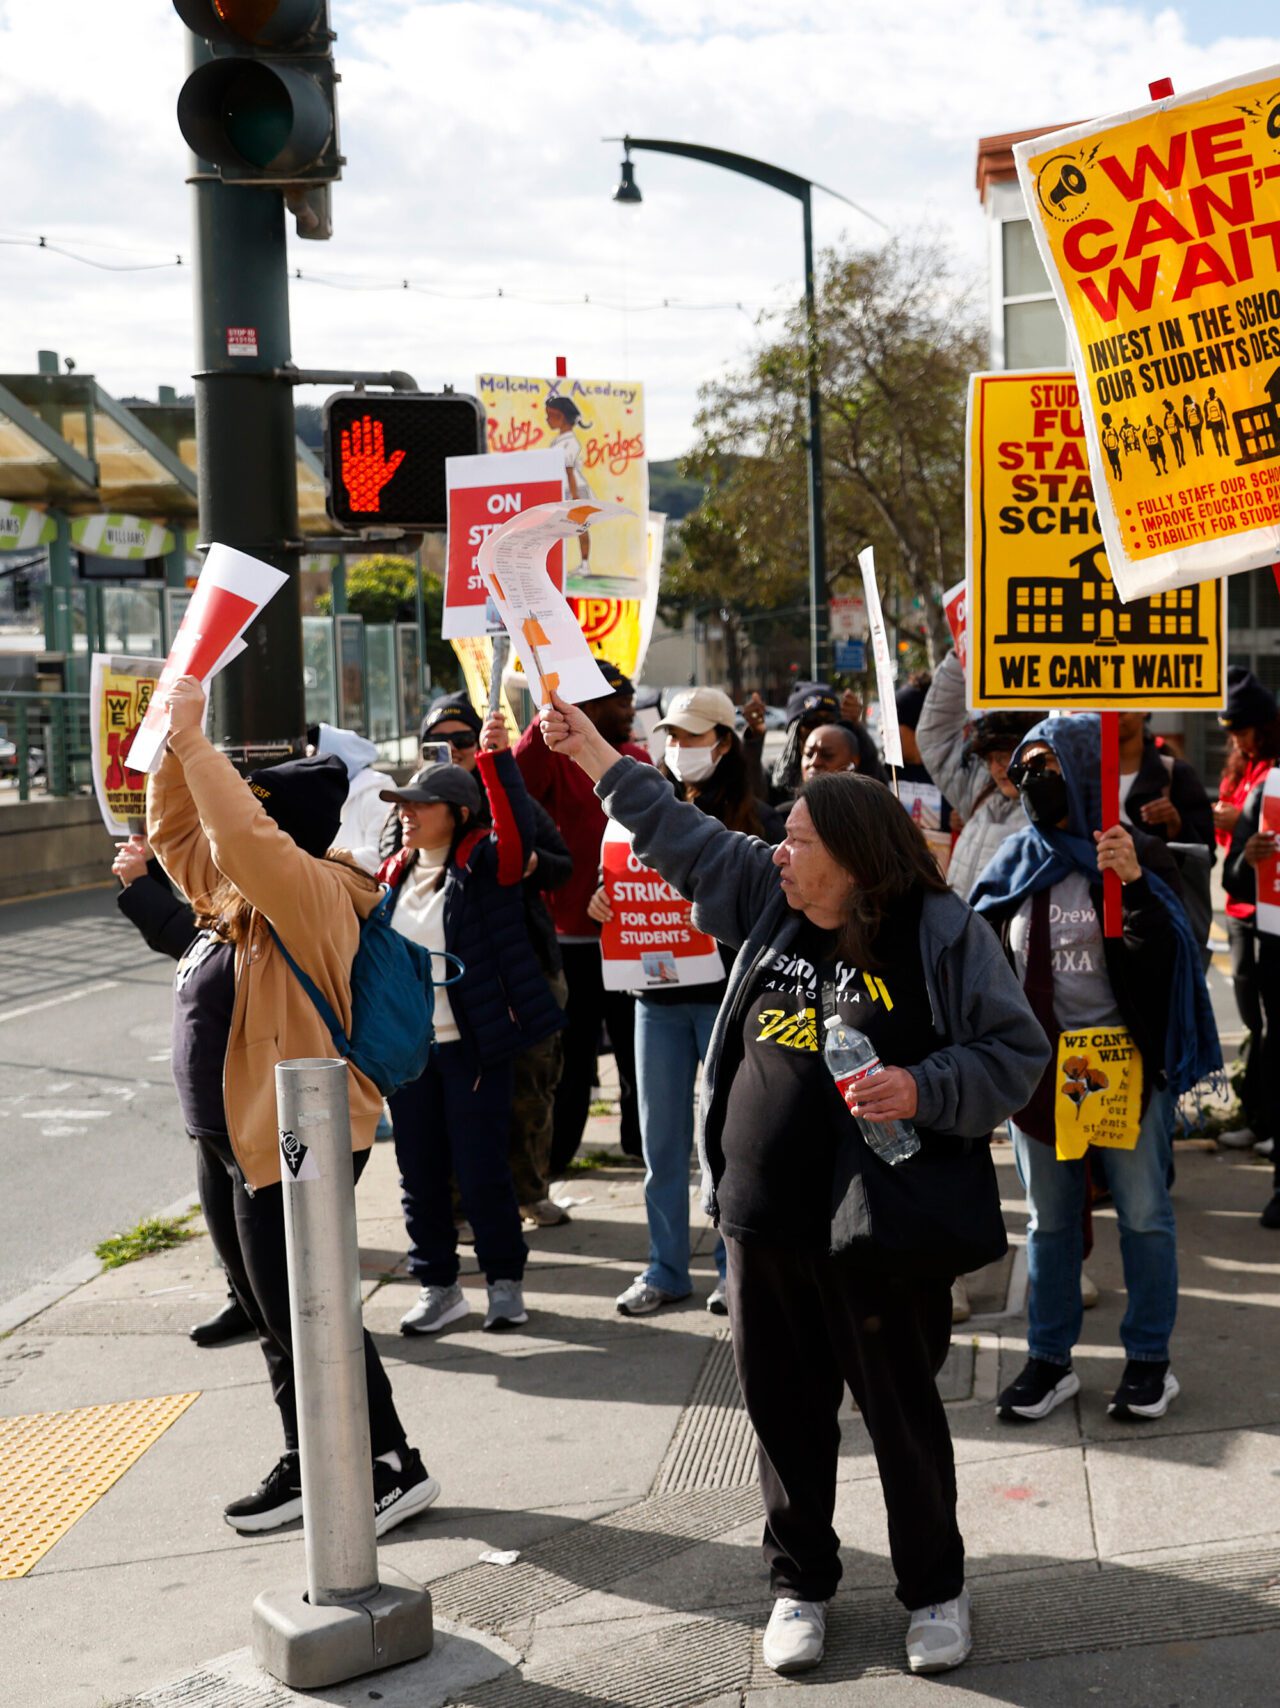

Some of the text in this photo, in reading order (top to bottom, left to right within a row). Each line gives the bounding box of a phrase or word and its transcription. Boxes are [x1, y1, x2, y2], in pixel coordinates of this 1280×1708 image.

[1097, 118, 1254, 202] WE
[1088, 325, 1154, 374] INVEST
[1158, 317, 1185, 352] IN
[1188, 304, 1235, 342] THE
[1096, 368, 1137, 406] OUR
[1139, 336, 1250, 394] STUDENTS
[480, 375, 637, 404] Malcolm X Academy
[584, 430, 645, 476] Bridges
[486, 492, 522, 514] ON
[1137, 495, 1180, 517] FULLY
[1178, 482, 1217, 506] STAFF
[1220, 478, 1247, 495] OUR
[1141, 508, 1200, 533] IMPROVE
[1200, 492, 1264, 517] EDUCATOR
[106, 528, 146, 546] WILLIAMS
[1146, 521, 1207, 550] STABILITY
[1210, 515, 1238, 533] FOR
[999, 654, 1203, 689] WE CAN'T WAIT!
[620, 911, 682, 926] FOR OUR
[1049, 904, 1097, 924] Drew
[620, 930, 691, 944] STUDENTS
[772, 953, 856, 992] simy
[1064, 1035, 1087, 1048] WE
[1098, 1048, 1134, 1062] WAIT
